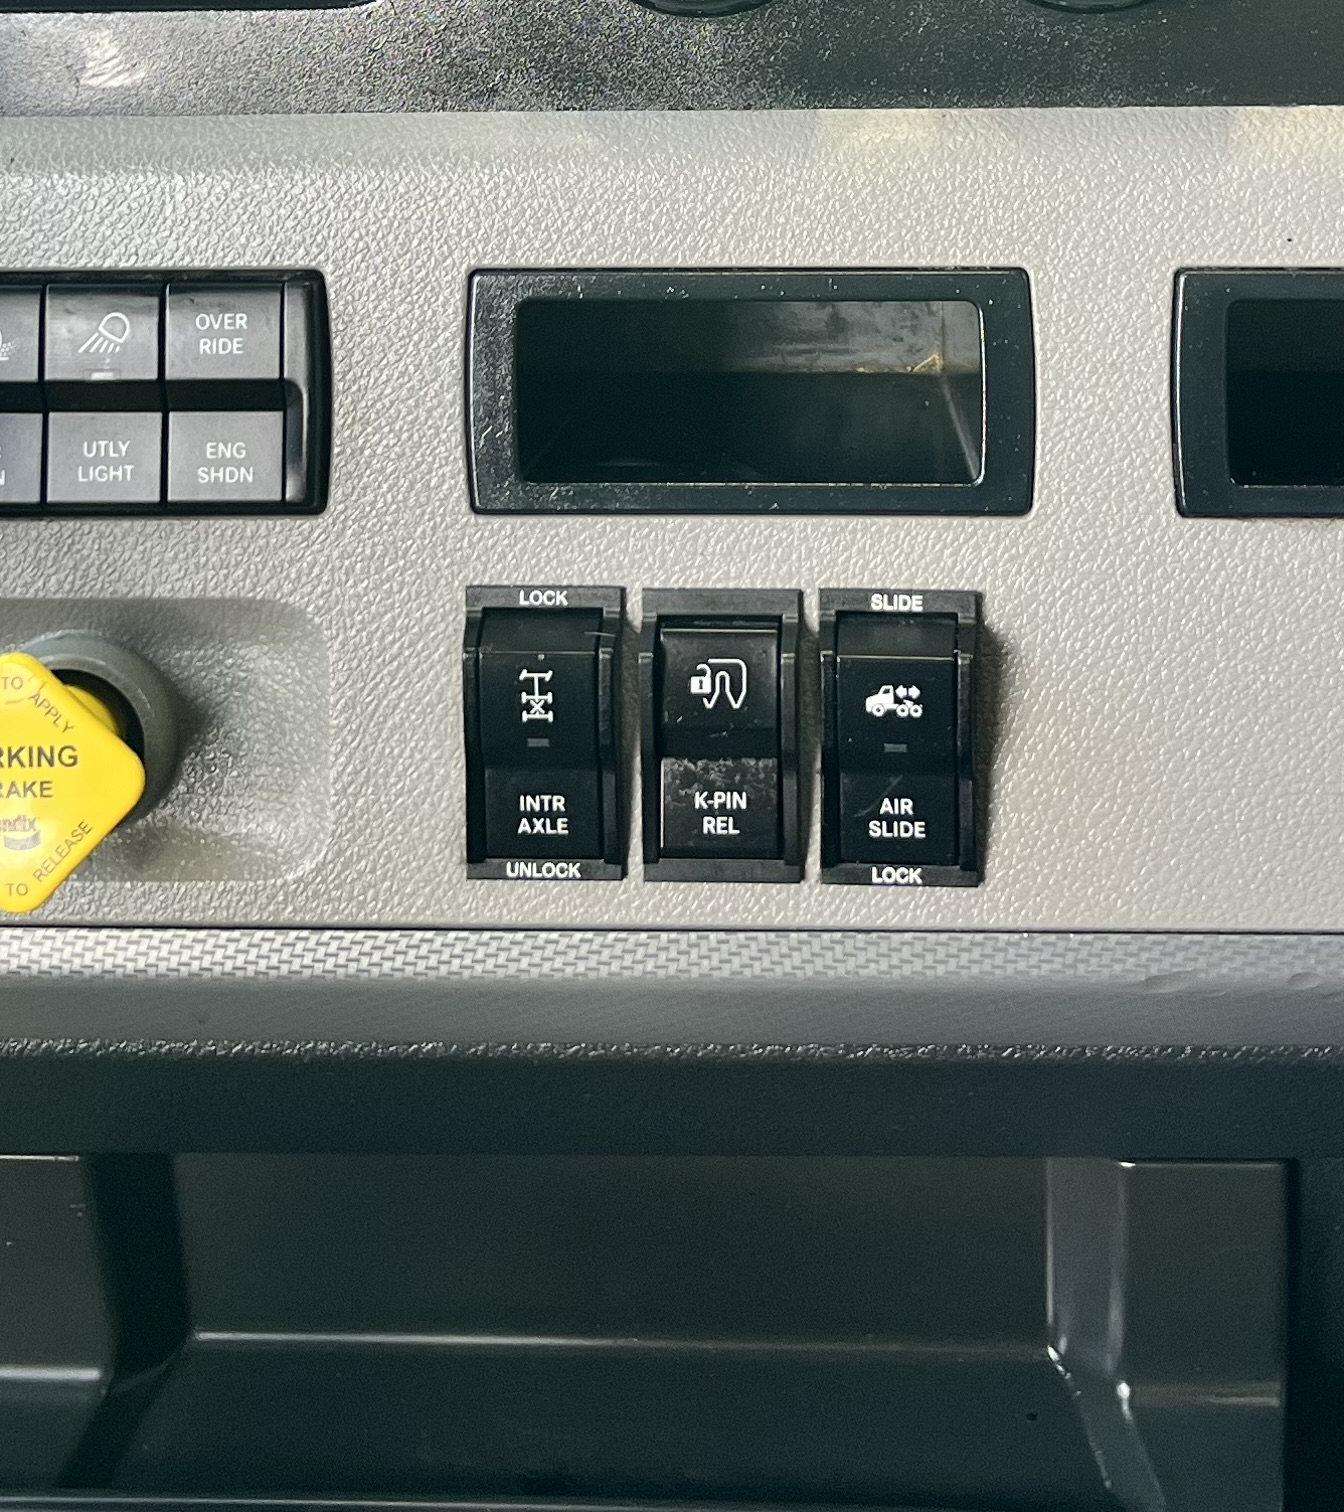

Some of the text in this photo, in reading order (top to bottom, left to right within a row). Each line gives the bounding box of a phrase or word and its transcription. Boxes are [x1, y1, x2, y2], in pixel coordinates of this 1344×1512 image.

[195, 313, 248, 331] OVER
[199, 337, 244, 355] RIDE
[83, 440, 130, 458] UTLY
[205, 441, 247, 459] ENG
[77, 464, 135, 483] LIGHT
[197, 466, 254, 484] SHDN
[519, 590, 568, 606] LOCK
[870, 594, 924, 611] SLIDE
[1, 676, 24, 691] TO
[28, 691, 75, 734] APPLY
[518, 794, 566, 813] INTR
[693, 791, 748, 810] K-PIN
[878, 797, 914, 815] AIR
[516, 817, 569, 835] AXLE
[702, 816, 740, 835] REL
[868, 821, 927, 838] SLIDE
[6, 882, 29, 897] TO
[32, 818, 95, 883] RELEASE
[505, 861, 582, 879] UNLOCK
[871, 866, 923, 884] LOCK
